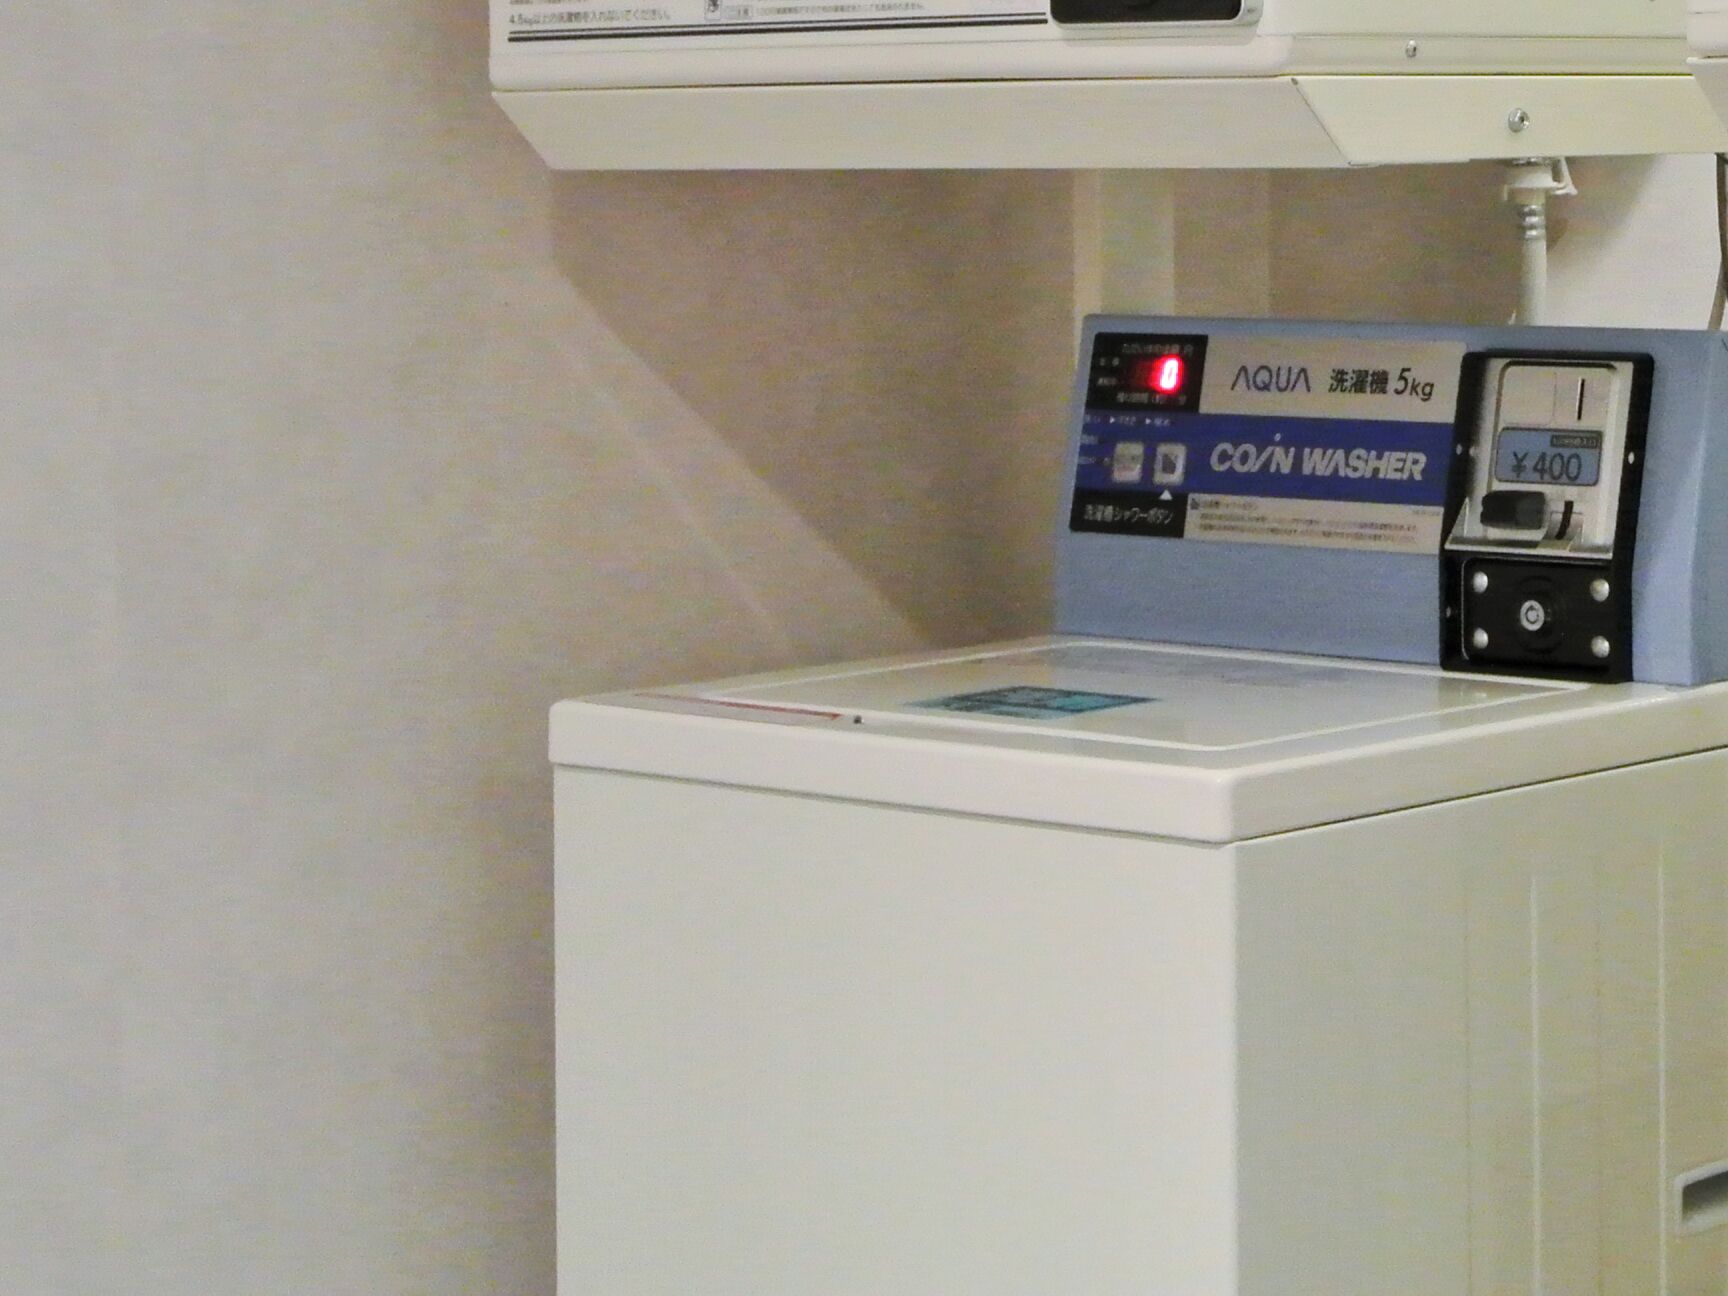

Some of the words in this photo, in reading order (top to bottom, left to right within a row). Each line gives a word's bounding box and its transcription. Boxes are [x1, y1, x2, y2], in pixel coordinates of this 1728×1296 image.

[1159, 358, 1179, 390] 0
[1231, 365, 1311, 394] AQUA
[1328, 368, 1389, 395] 洗濯機
[1394, 367, 1434, 402] 5kg
[1302, 446, 1427, 481] WASHER
[1511, 450, 1583, 482] ¥400
